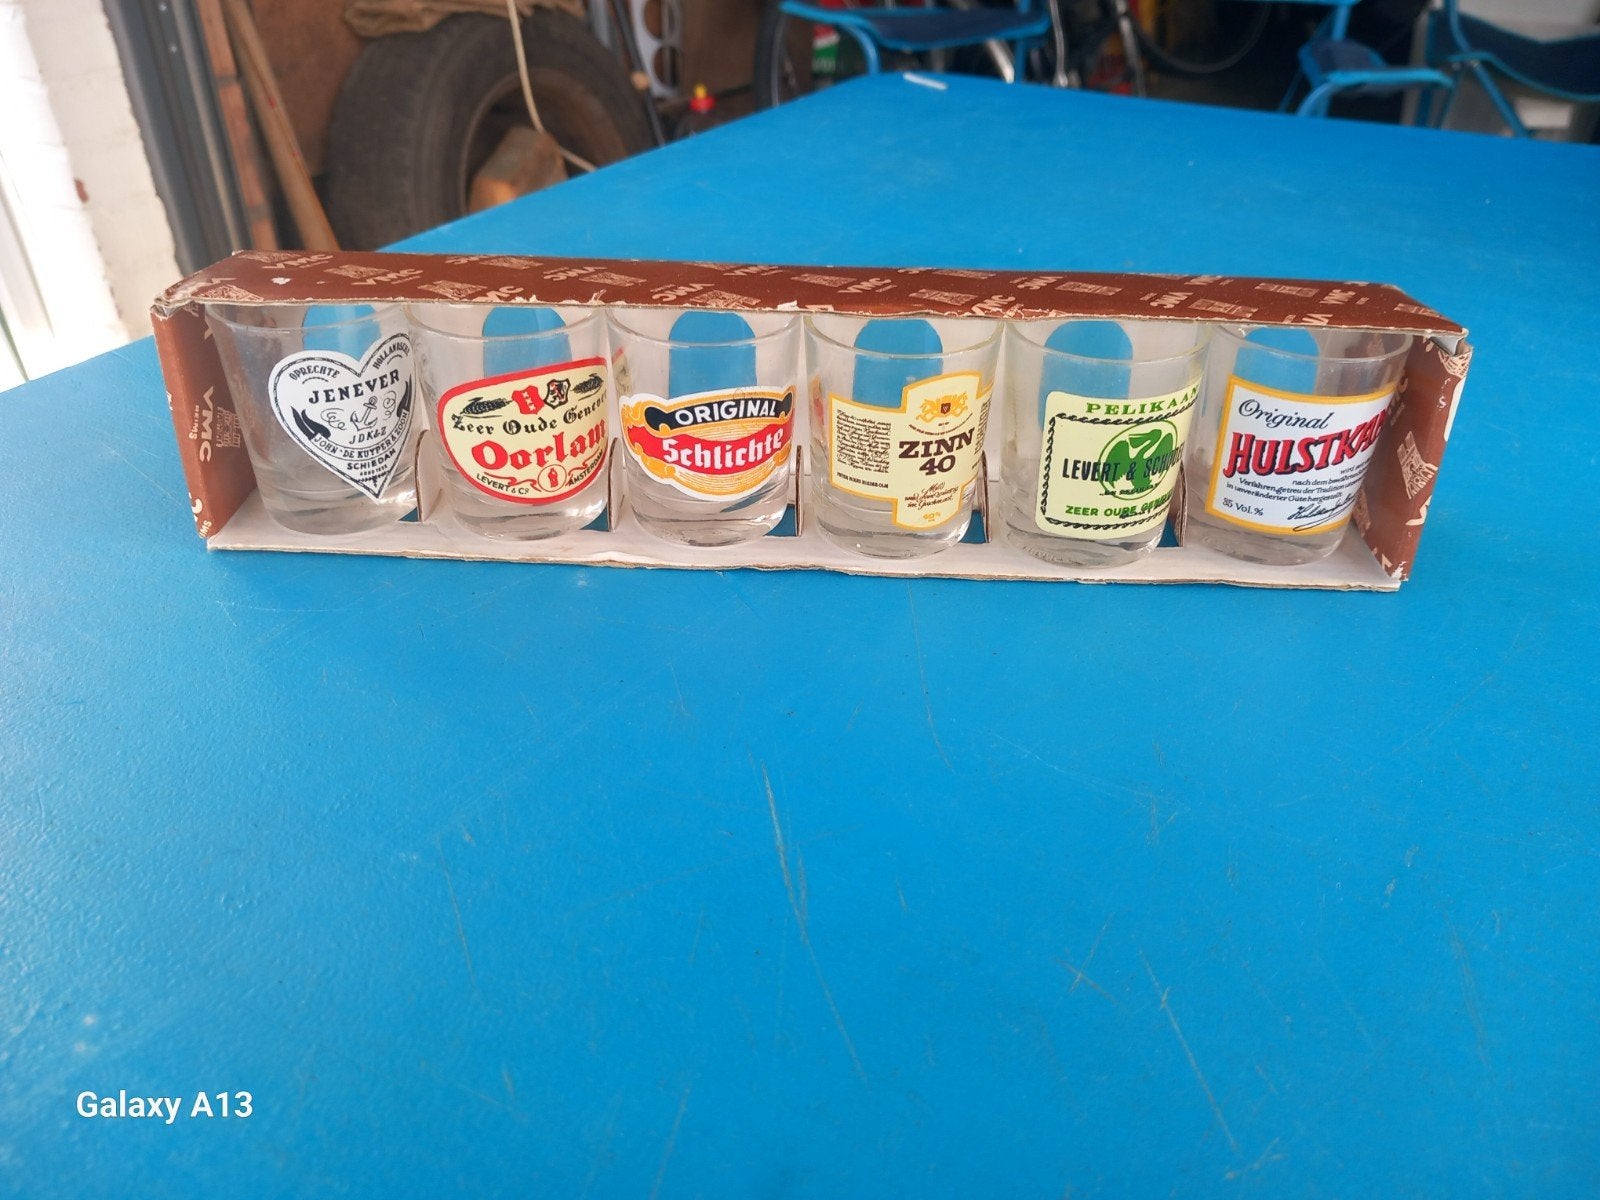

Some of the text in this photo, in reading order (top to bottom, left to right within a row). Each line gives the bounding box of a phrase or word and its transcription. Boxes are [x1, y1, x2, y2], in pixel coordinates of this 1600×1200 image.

[288, 365, 340, 381] OPRECHTE
[309, 369, 400, 405] JENEVER
[675, 399, 777, 426] ORIGINAL
[1086, 386, 1199, 415] PELIKAAN
[1238, 398, 1335, 431] Original
[199, 385, 214, 462] VMC
[313, 434, 339, 454] JOHN
[342, 449, 356, 459] DE
[357, 439, 393, 459] KUYPER
[394, 411, 408, 436] ZOON
[452, 413, 495, 436] Zeer
[503, 416, 557, 436] Oude
[471, 419, 606, 471] Oorlam
[662, 427, 785, 470] Schlichte
[898, 427, 976, 460] ZINN
[346, 448, 396, 471] SCHIEDAM
[919, 454, 956, 476] 40
[1062, 458, 1120, 482] LEVERT
[1125, 460, 1137, 481] &
[476, 473, 511, 492] LEVERT
[1065, 505, 1099, 517] ZEER
